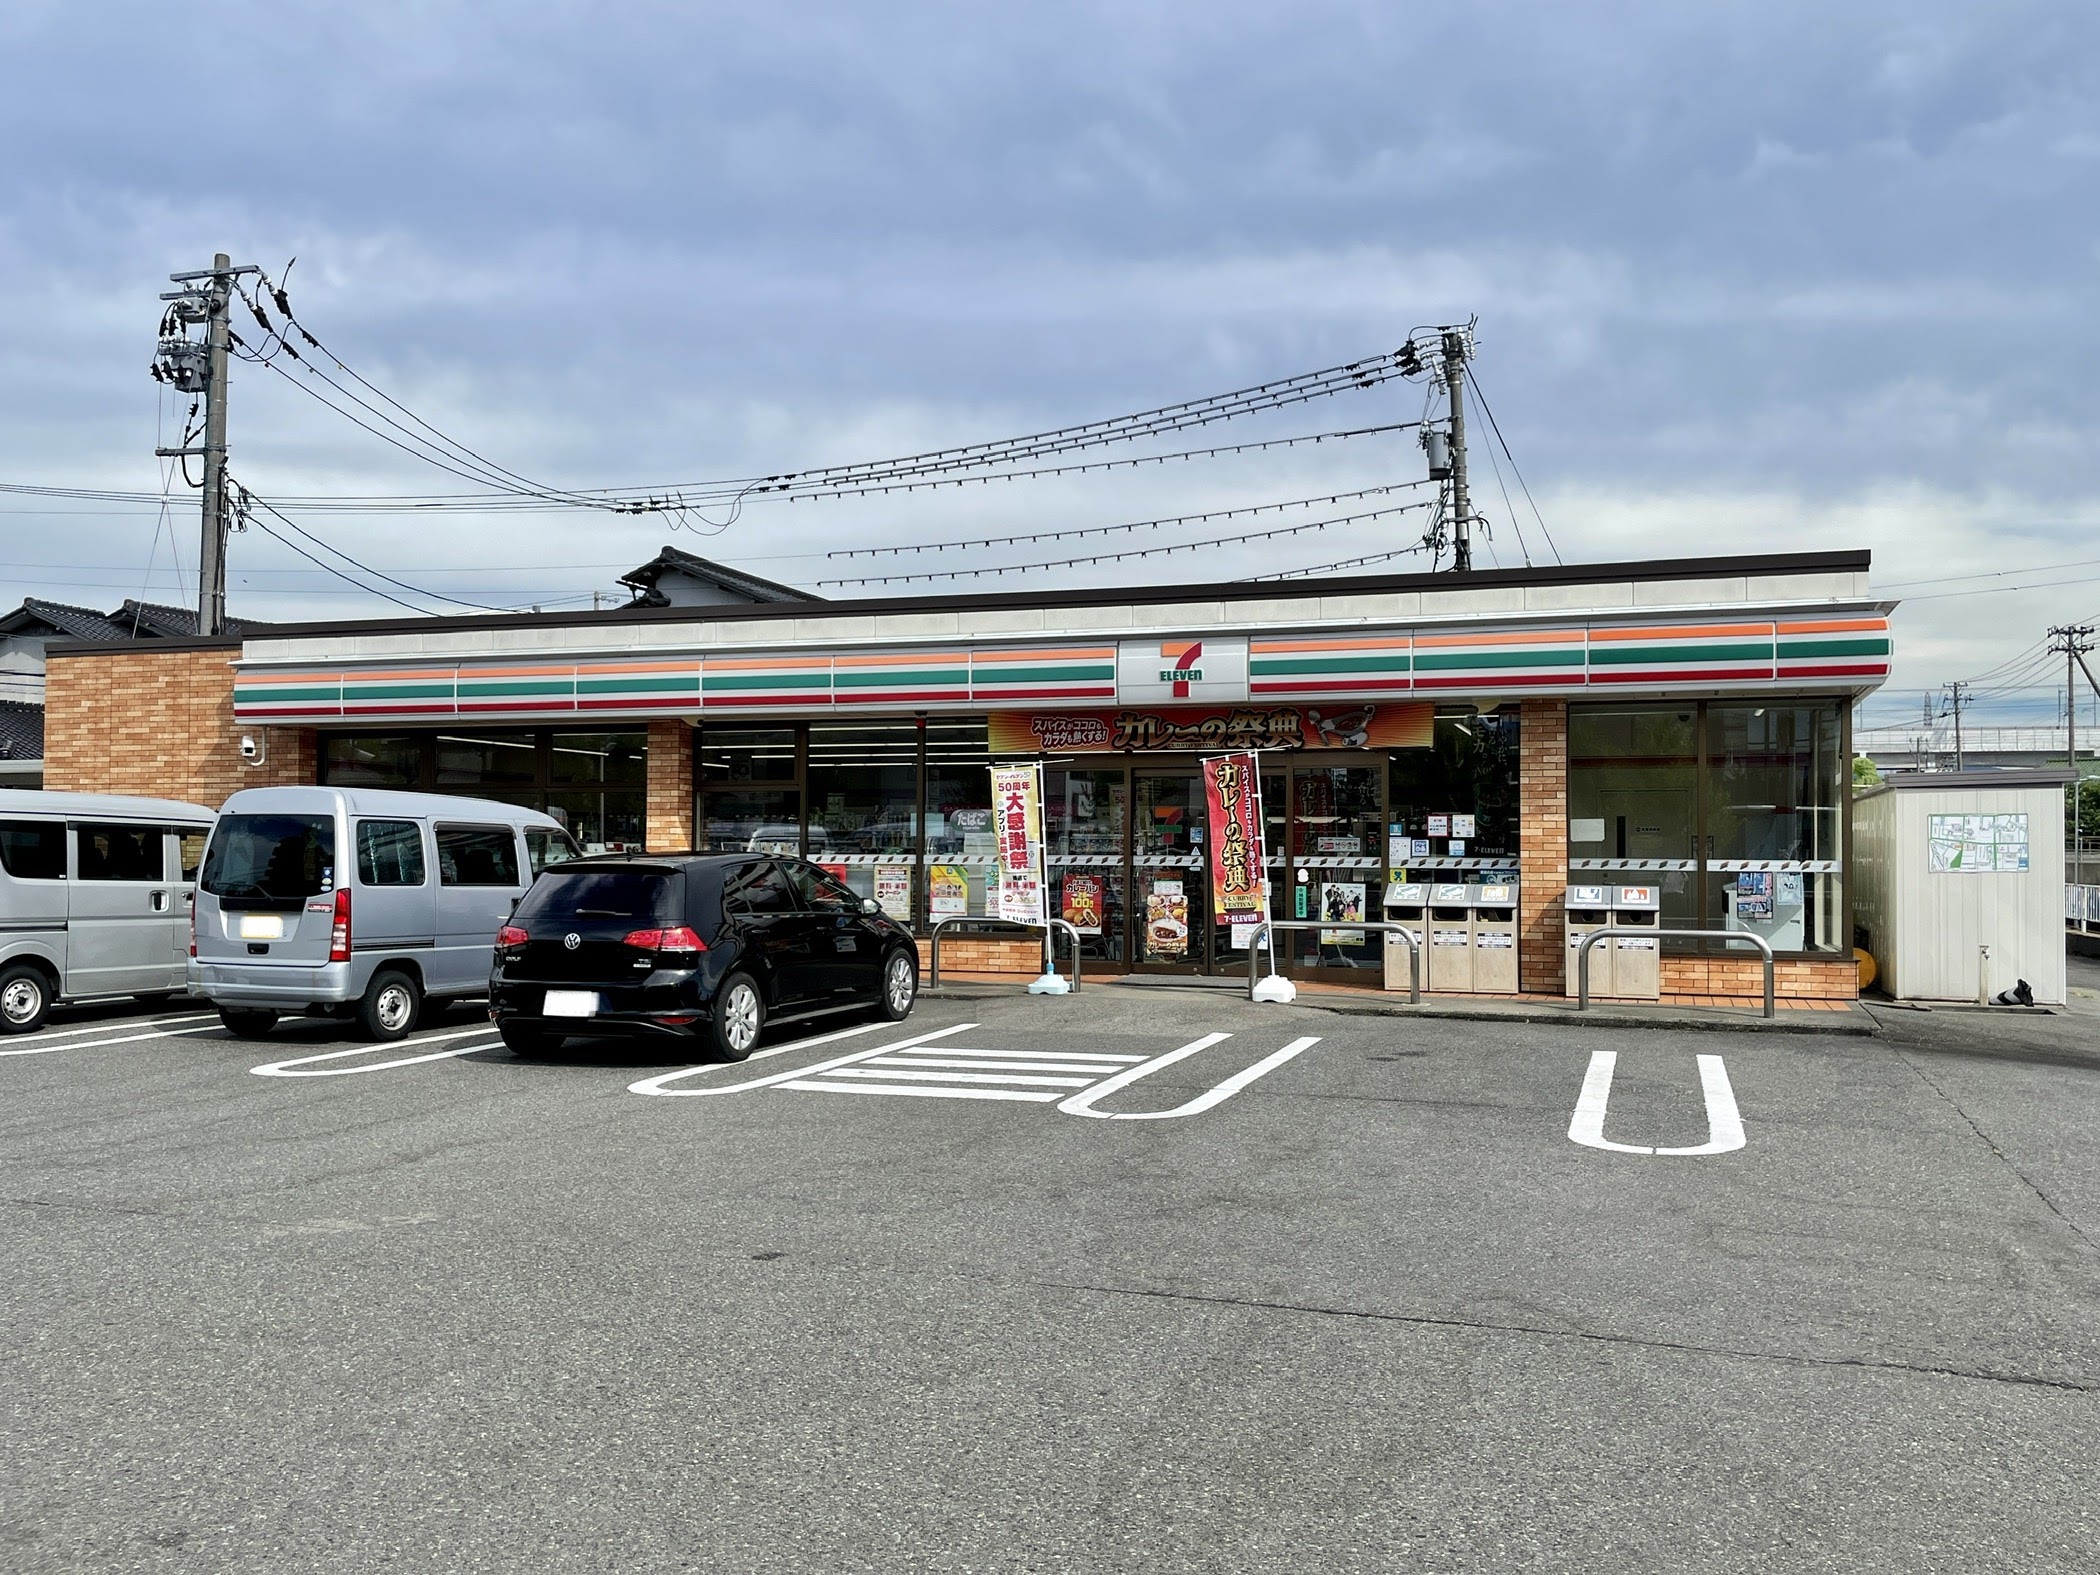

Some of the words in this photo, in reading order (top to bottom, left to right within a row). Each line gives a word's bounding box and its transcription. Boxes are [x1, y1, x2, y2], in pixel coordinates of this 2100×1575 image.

[1114, 710, 1302, 749] カレーの祭典
[998, 781, 1031, 792] 50周年
[957, 811, 986, 826] たばこ
[1006, 792, 1028, 870] 大感謝祭
[1216, 763, 1251, 892] カレーの祭典
[1066, 883, 1099, 893] カレーパン
